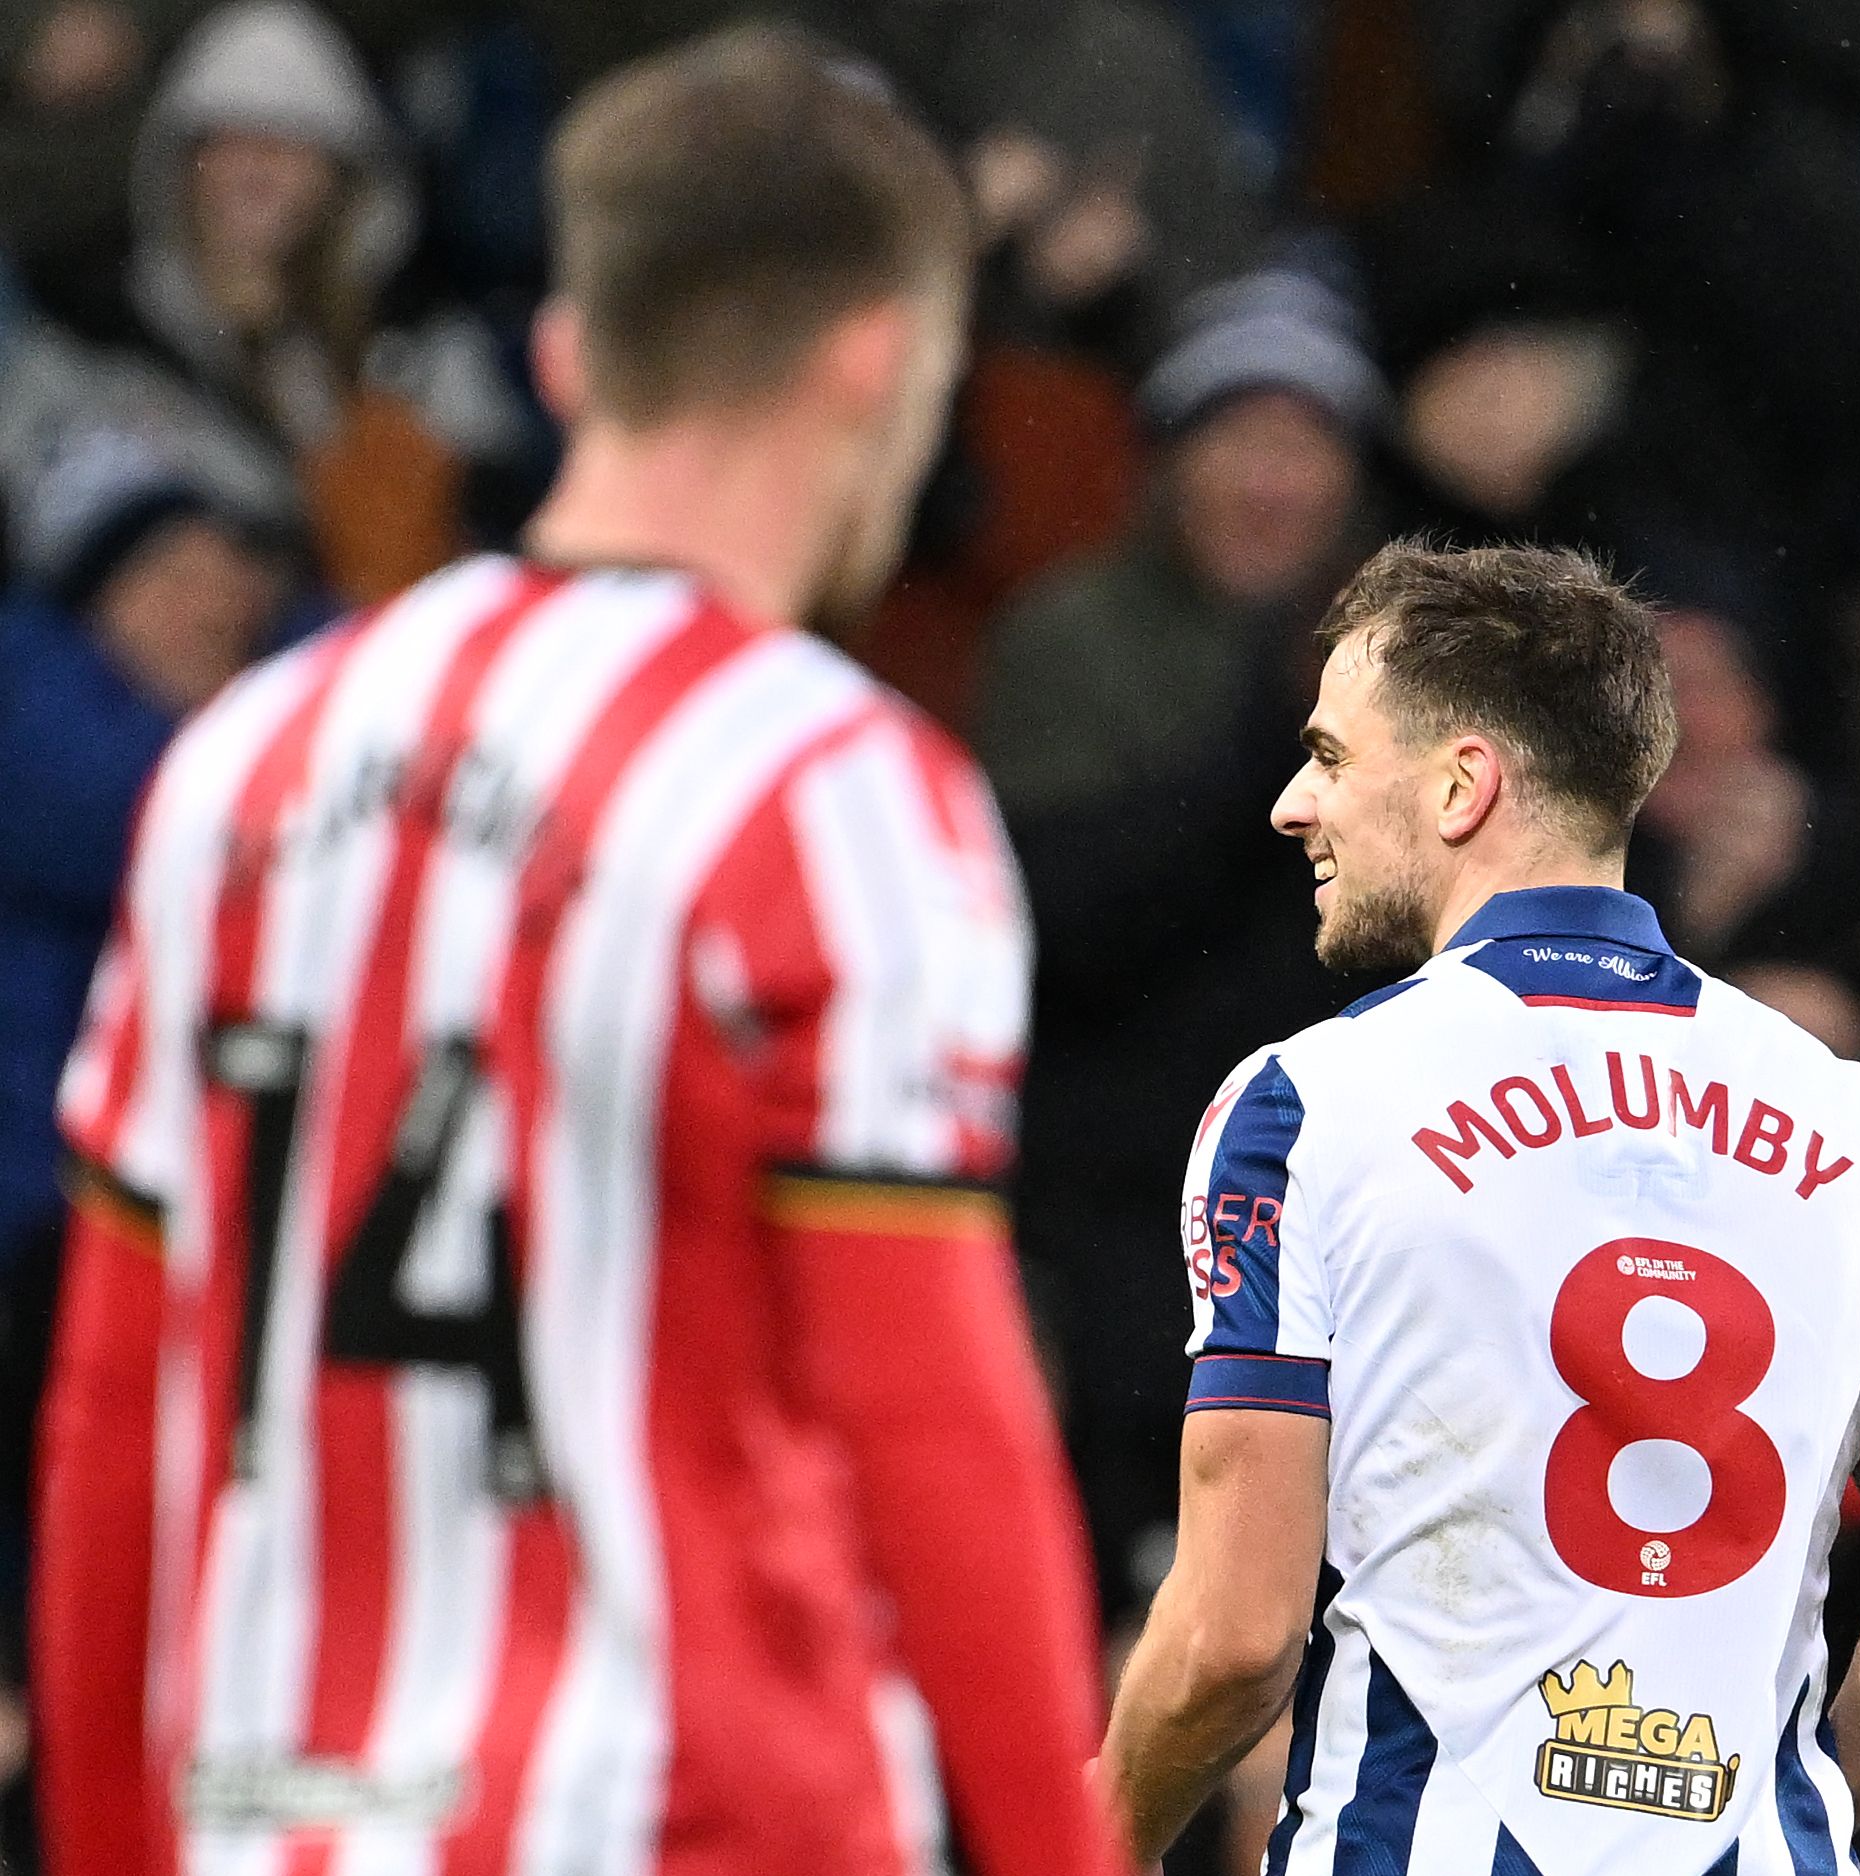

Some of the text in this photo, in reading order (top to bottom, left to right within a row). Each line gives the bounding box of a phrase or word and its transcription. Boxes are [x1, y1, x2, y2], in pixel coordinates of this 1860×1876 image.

[1523, 948, 1658, 982] We are Albion
[1412, 1051, 1855, 1200] MOLUMBY
[202, 1018, 556, 1500] 14
[1185, 1245, 1243, 1301] SS
[1637, 1266, 1697, 1281] COMMUNITY
[1652, 1258, 1665, 1269] IN
[1664, 1259, 1685, 1271] THE
[1544, 1236, 1787, 1598] 8
[1641, 1571, 1668, 1587] EFL
[1556, 1707, 1720, 1762] MEGA
[1550, 1752, 1714, 1810] RICHES
